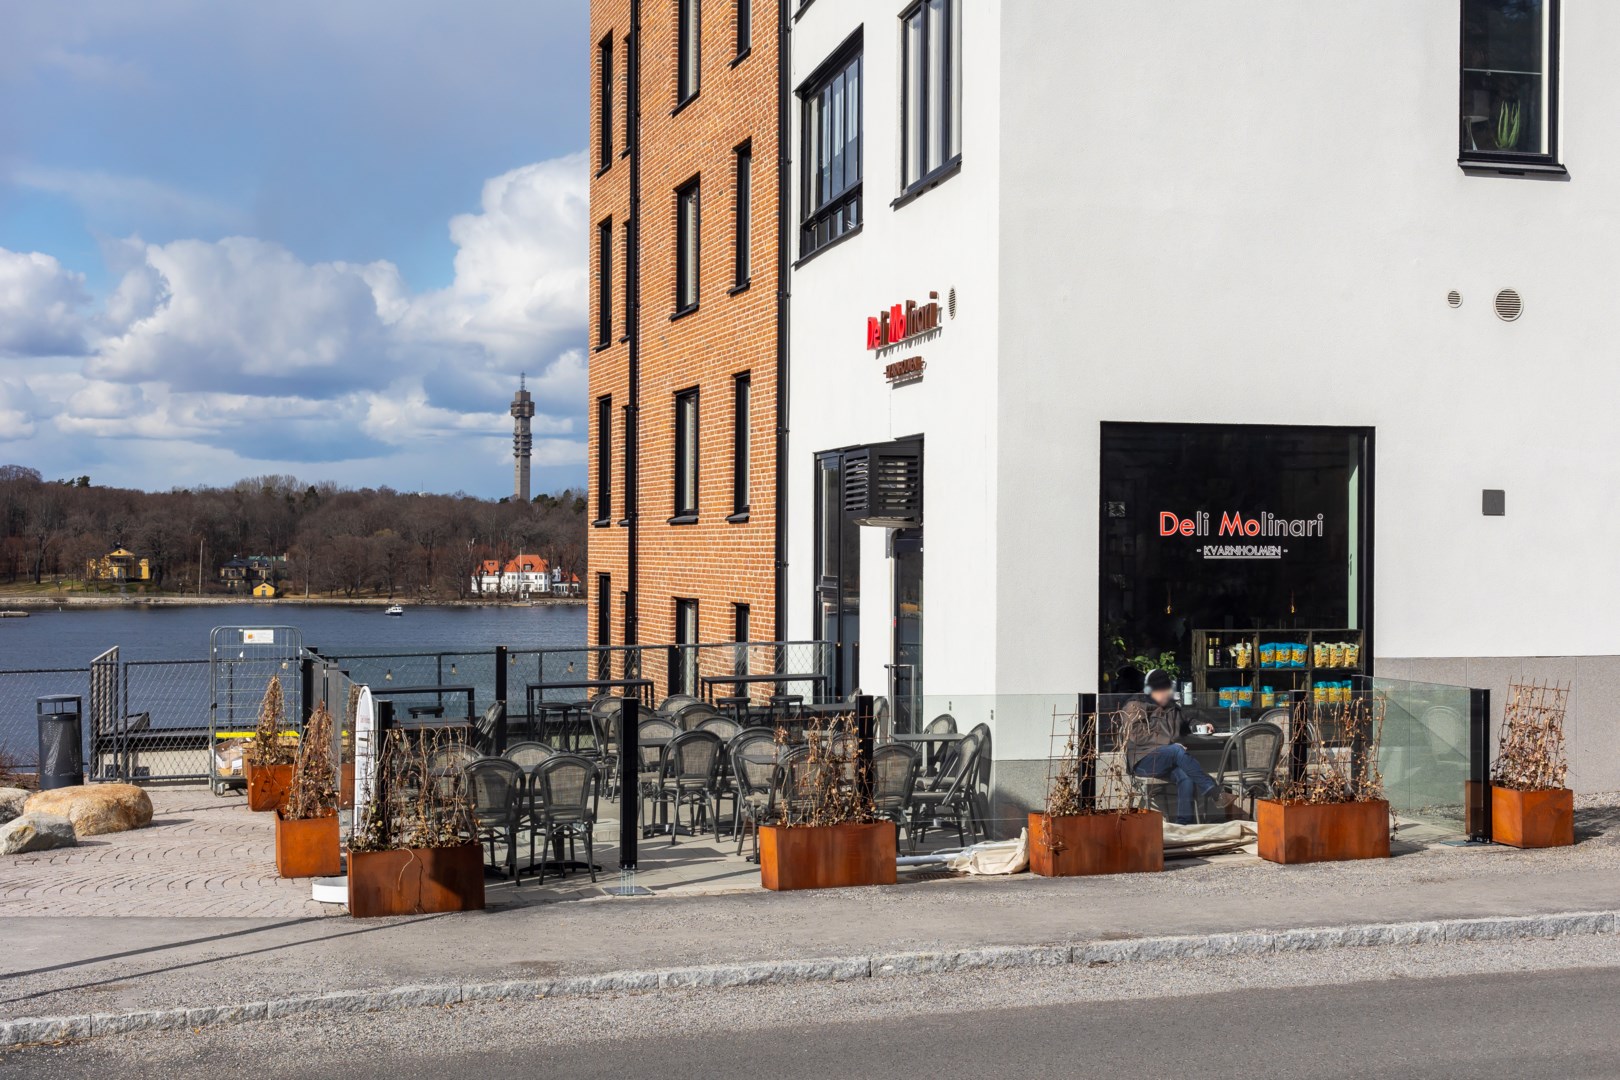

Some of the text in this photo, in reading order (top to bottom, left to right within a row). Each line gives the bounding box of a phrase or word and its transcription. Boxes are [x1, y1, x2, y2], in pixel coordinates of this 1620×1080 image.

[867, 291, 938, 351] Deli Molinari
[1159, 510, 1324, 537] Deli Molinari
